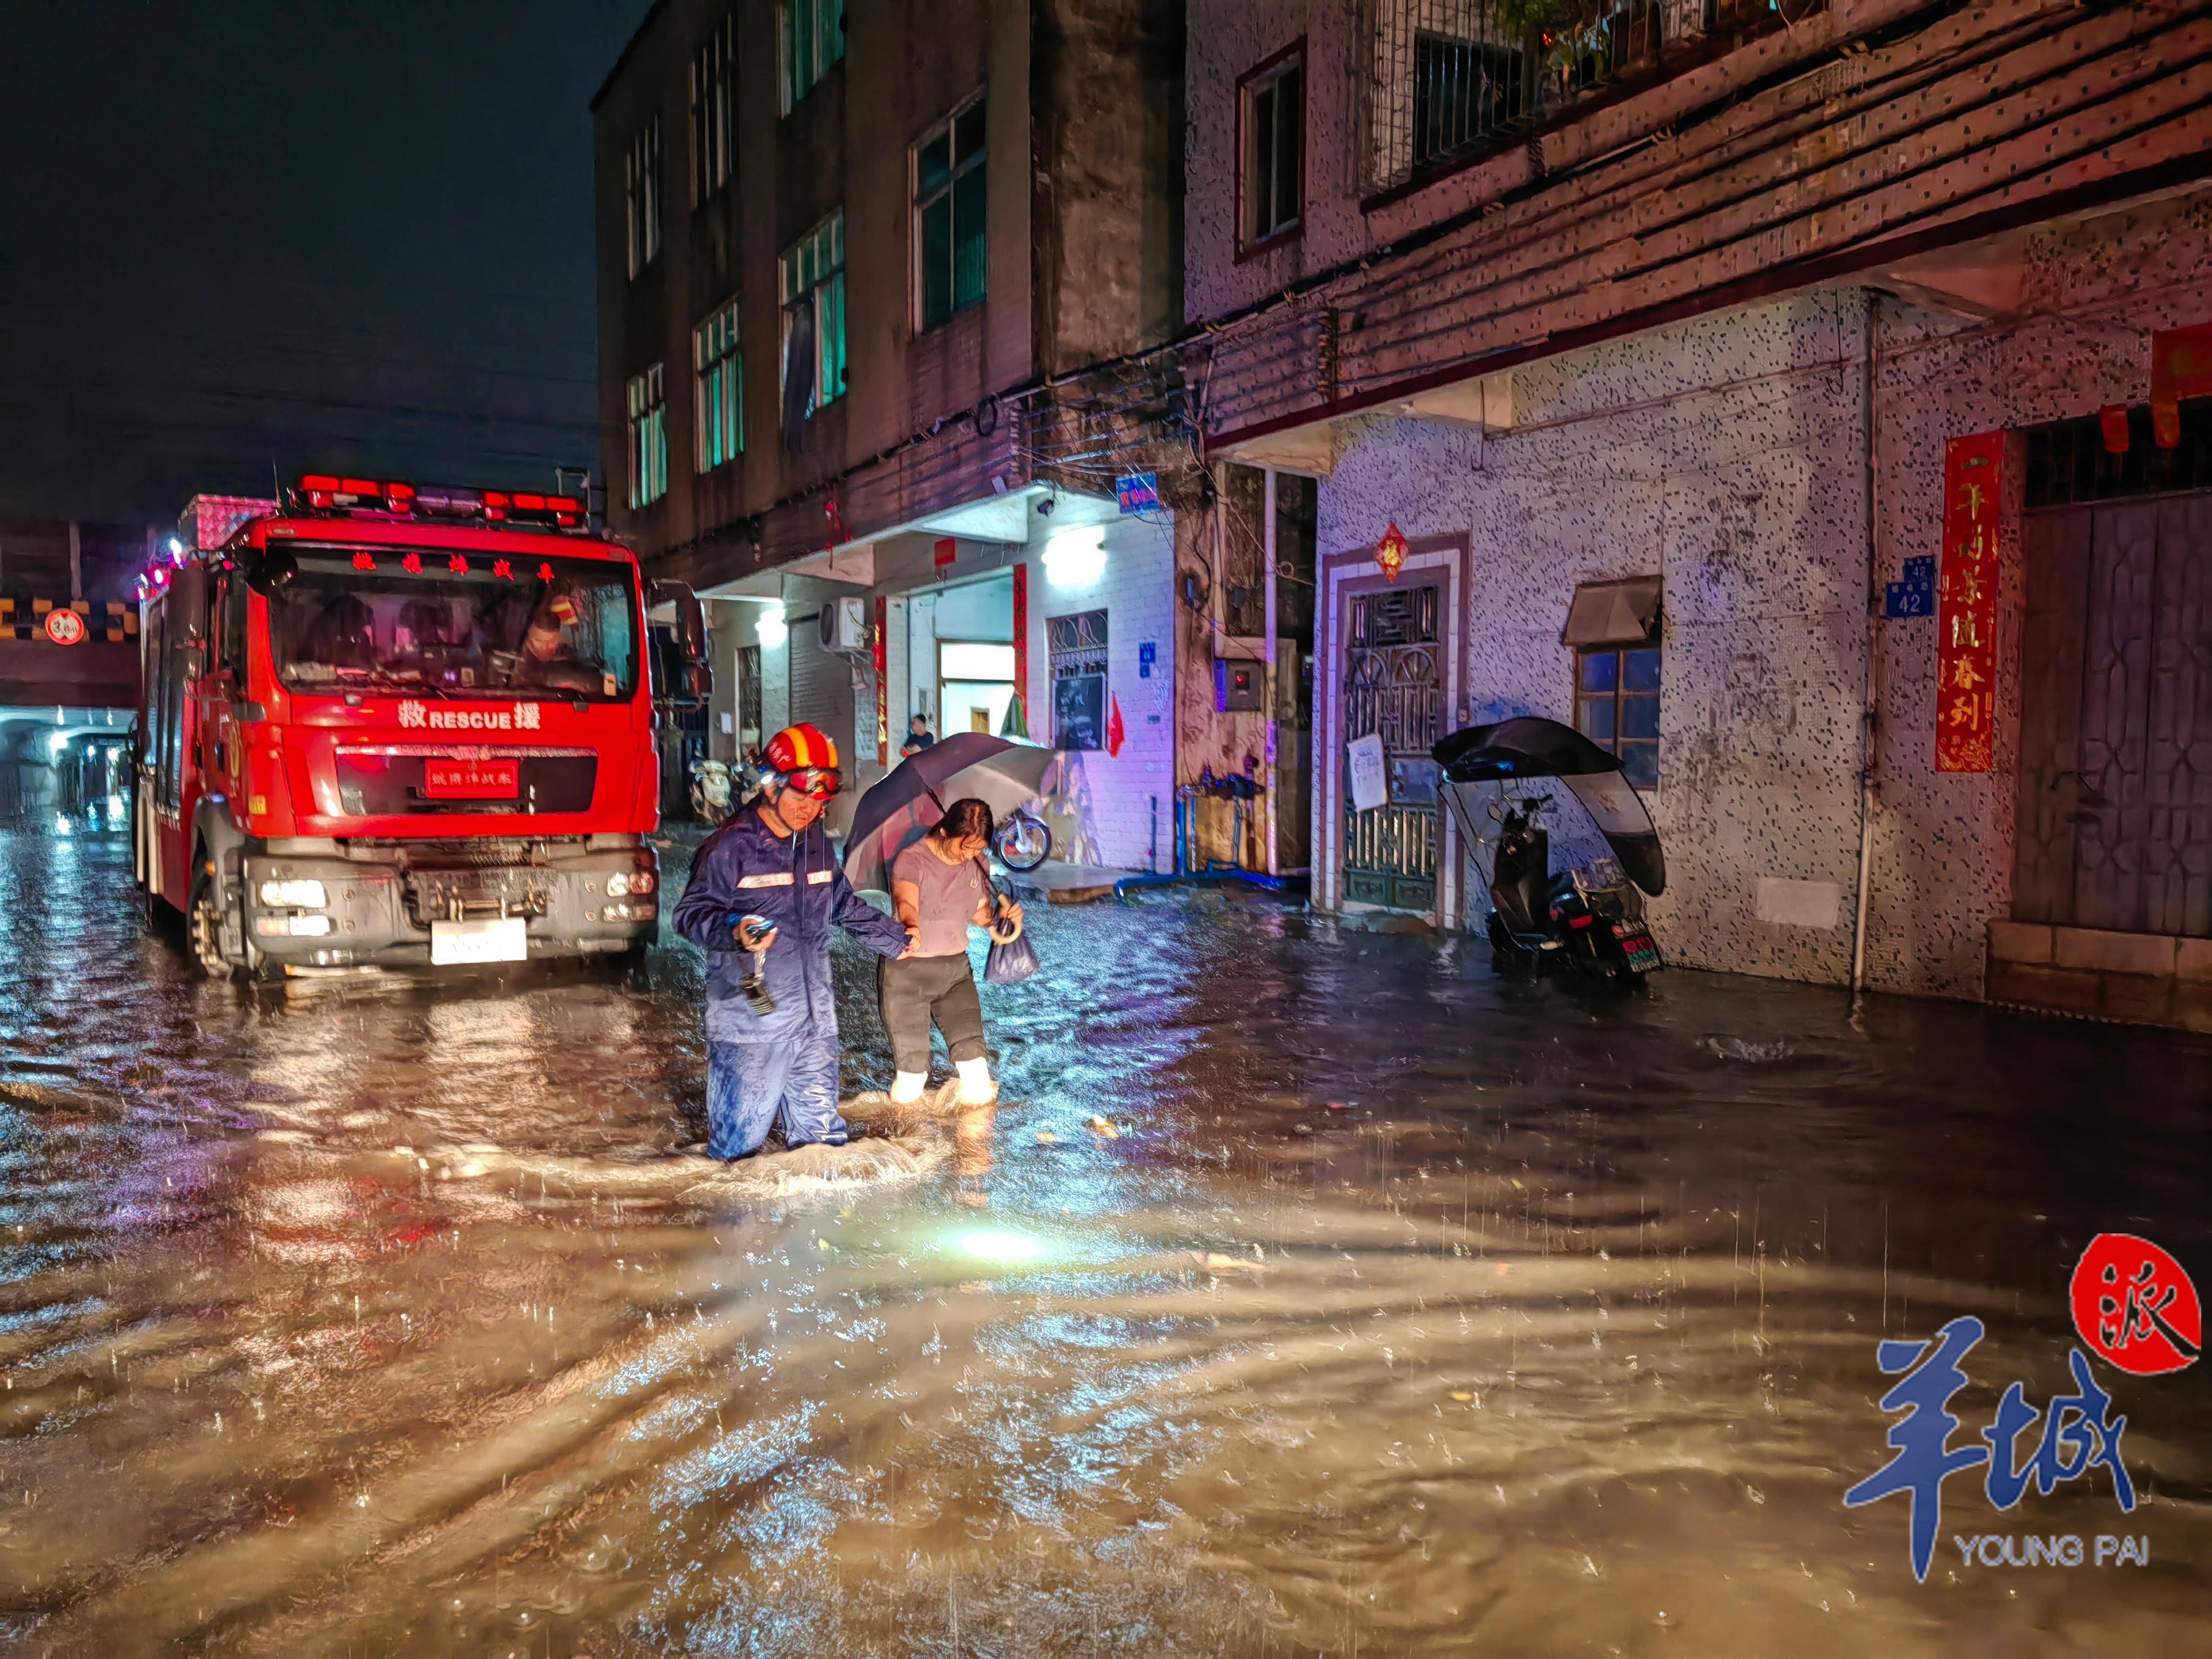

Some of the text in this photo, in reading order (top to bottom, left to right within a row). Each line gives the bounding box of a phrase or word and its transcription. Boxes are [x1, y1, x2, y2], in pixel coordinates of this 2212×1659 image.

[1899, 594, 1920, 612] 42
[398, 700, 541, 730] 救 RESCUE 援
